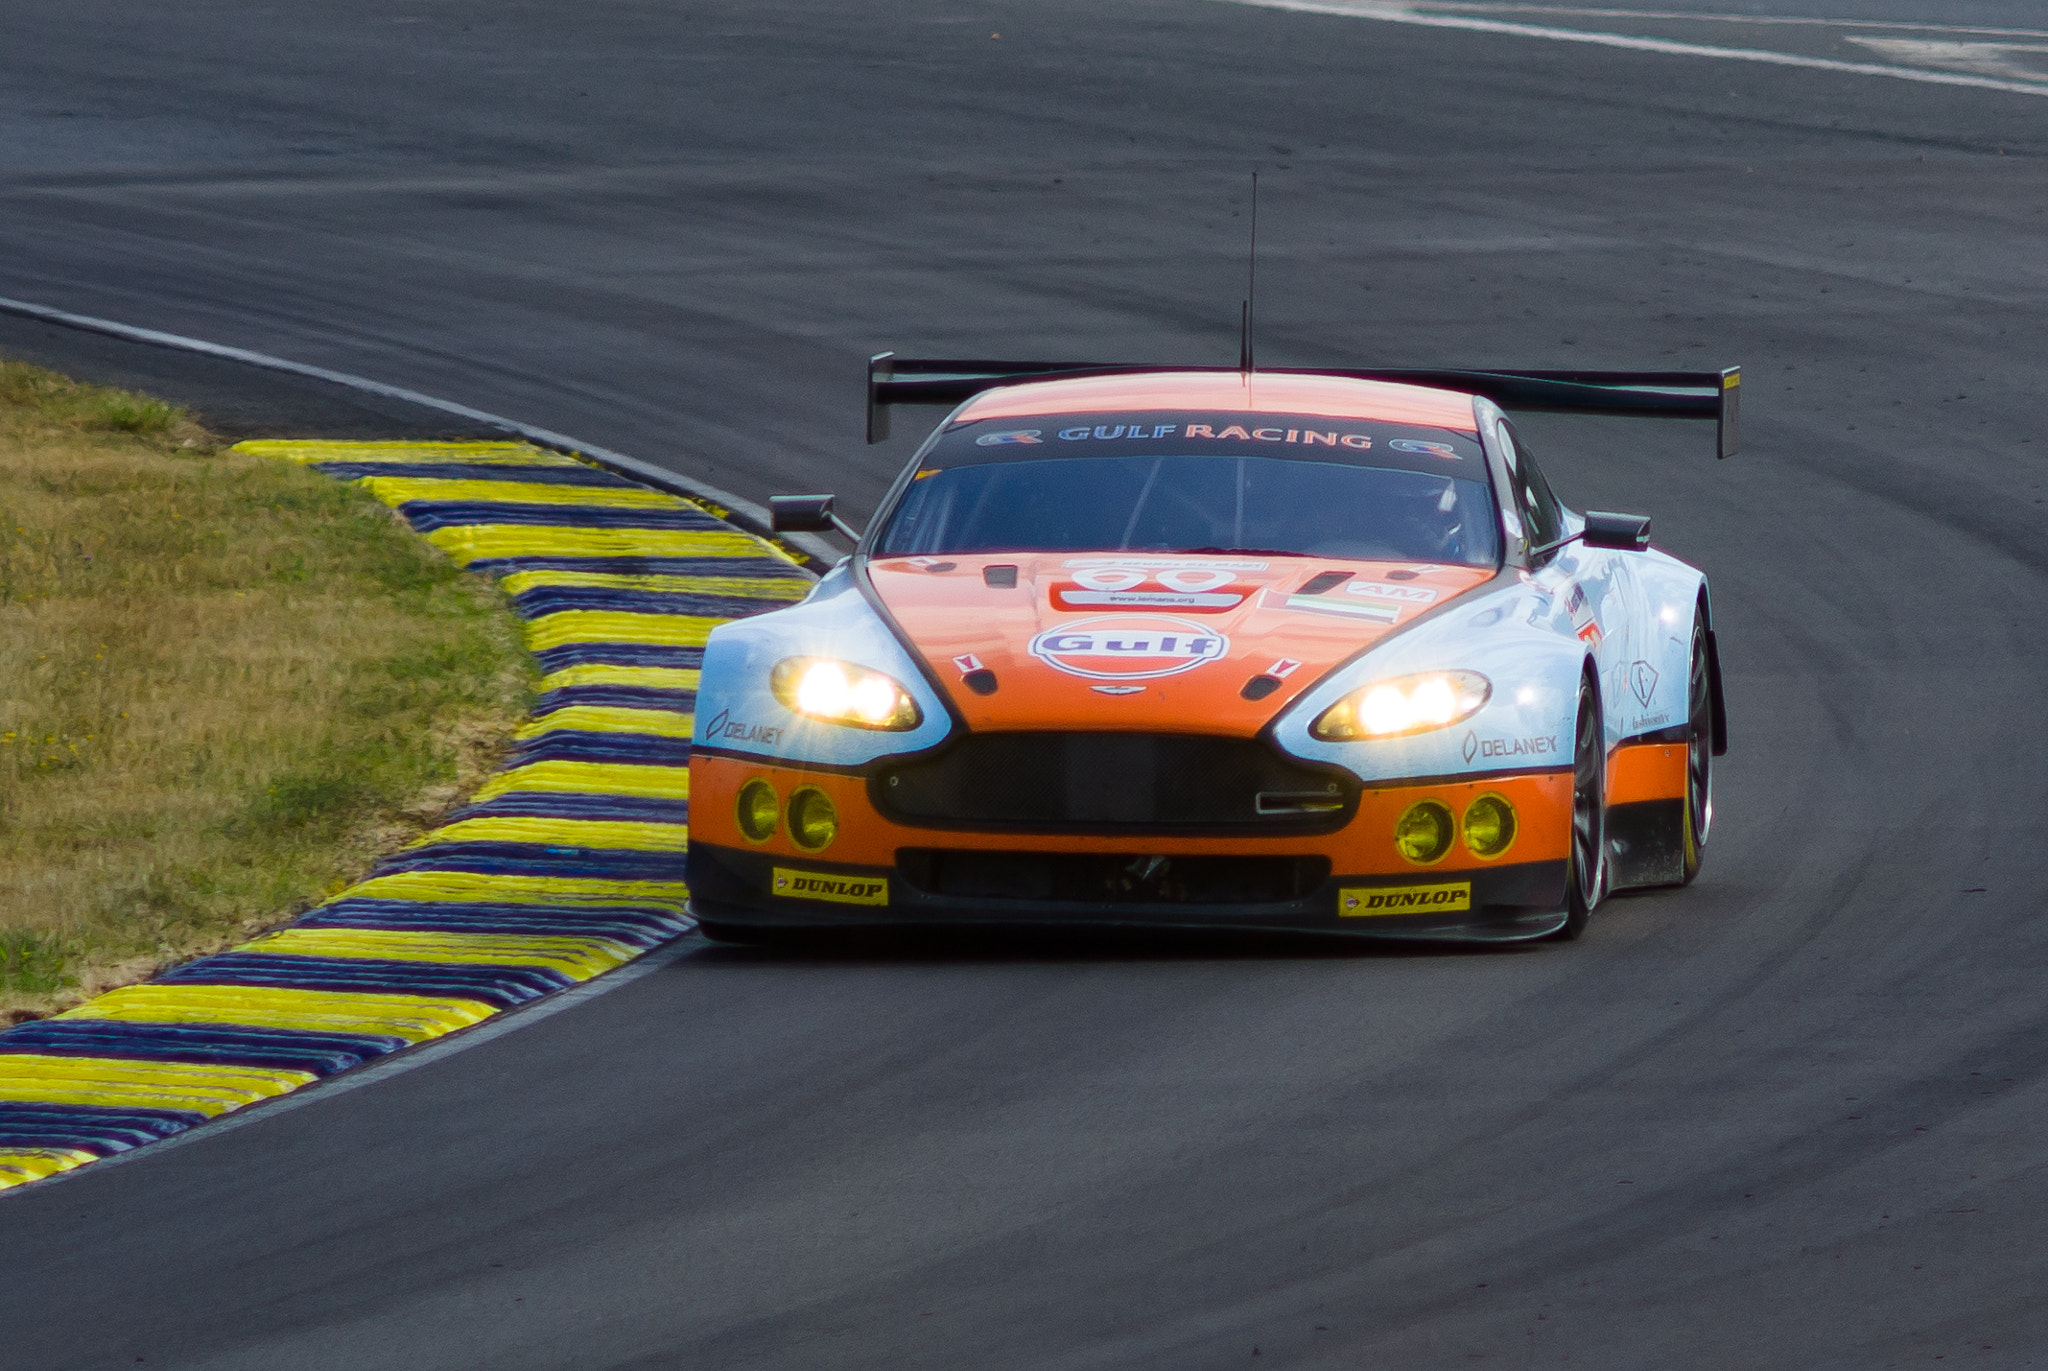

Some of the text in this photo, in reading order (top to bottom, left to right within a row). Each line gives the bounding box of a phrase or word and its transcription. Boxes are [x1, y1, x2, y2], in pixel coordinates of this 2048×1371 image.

[1058, 424, 1372, 450] GULF RACING
[1071, 567, 1238, 594] 60
[1109, 595, 1196, 604] www.lemans.org
[1354, 584, 1433, 600] AM
[1041, 634, 1217, 655] Gulf
[722, 721, 785, 746] DELANEY
[1481, 735, 1557, 758] DELANEY
[792, 877, 883, 898] DUNLOP
[1365, 889, 1468, 909] DUNLOP
